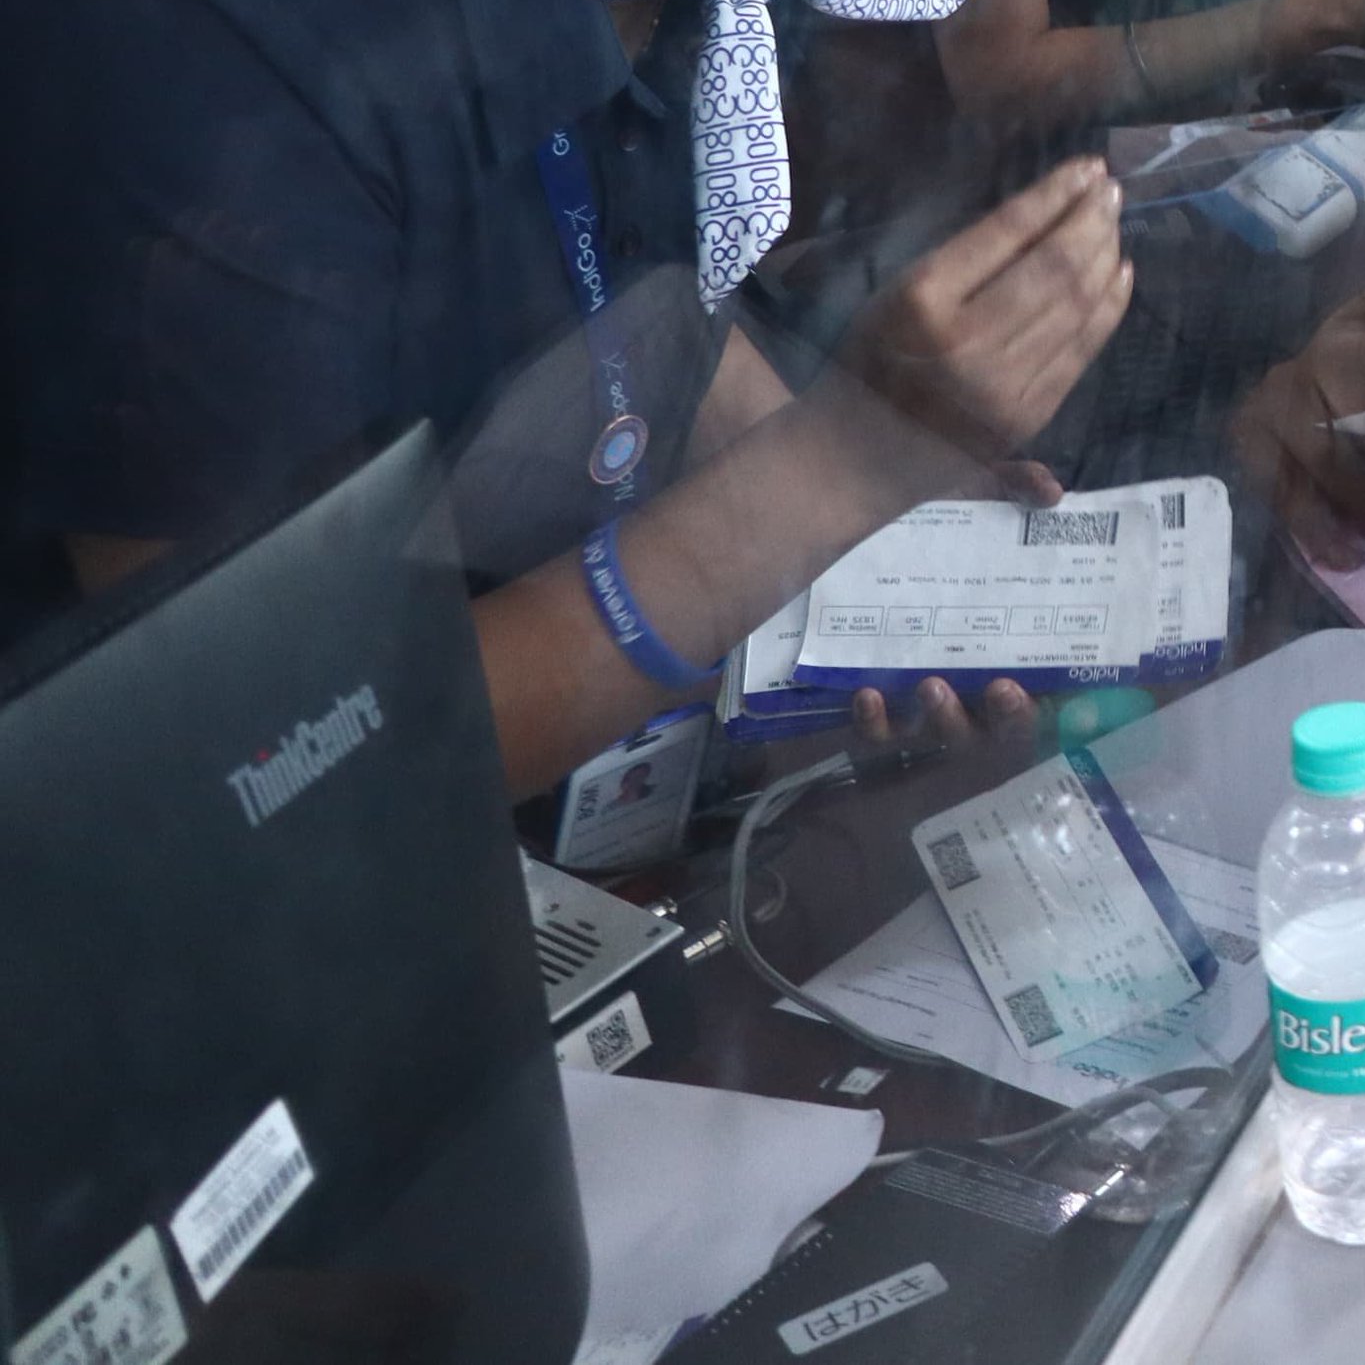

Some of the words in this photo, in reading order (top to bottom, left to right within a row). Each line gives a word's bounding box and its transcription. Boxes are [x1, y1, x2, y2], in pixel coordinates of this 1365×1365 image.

[576, 232, 605, 312] IndiGo
[1068, 666, 1120, 682] IndiGo
[226, 683, 384, 830] ThinkCentre
[803, 1275, 926, 1342] はがき
